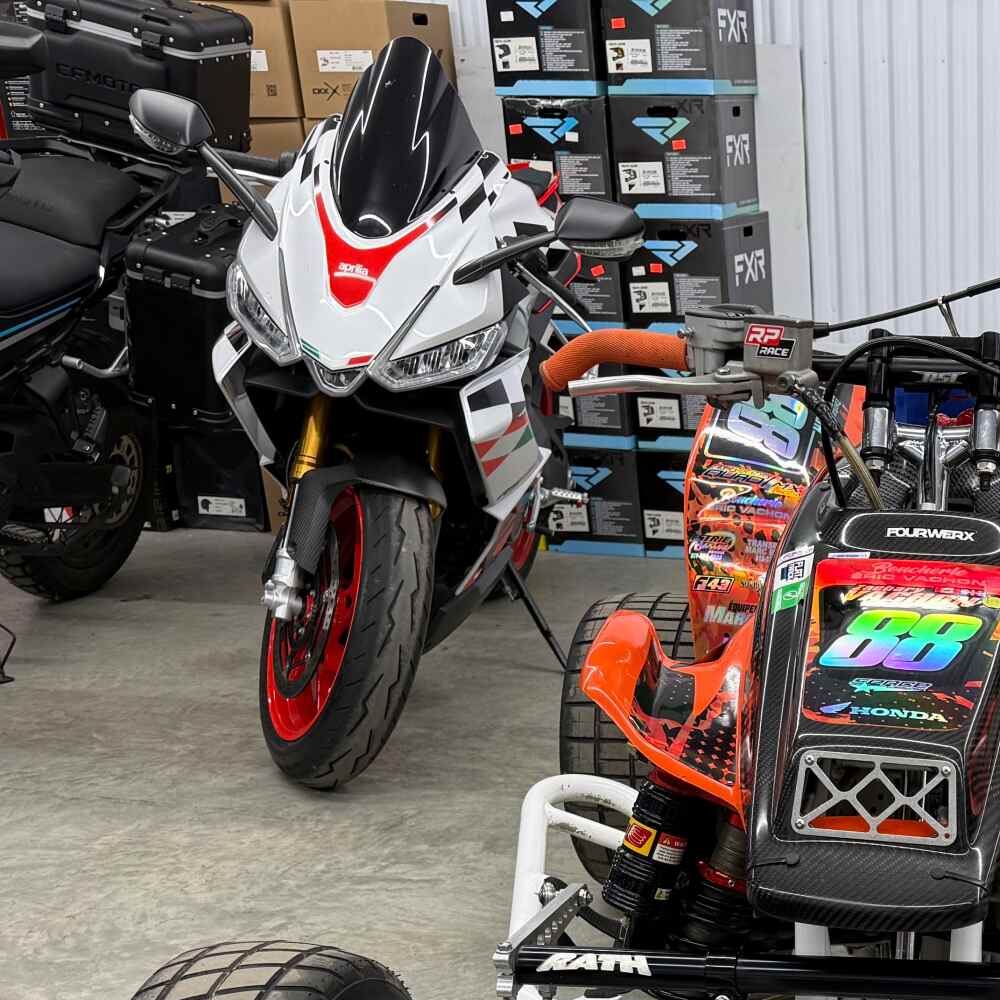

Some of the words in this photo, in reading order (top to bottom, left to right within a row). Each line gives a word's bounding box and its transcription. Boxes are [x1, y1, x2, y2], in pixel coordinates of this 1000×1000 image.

[717, 8, 748, 43] FXR
[726, 133, 750, 167] FXR
[338, 262, 369, 276] aprilia
[734, 248, 766, 287] FXR
[748, 326, 781, 344] RP
[759, 346, 789, 356] RACE
[886, 527, 976, 542] FOURWERX
[904, 574, 986, 587] VACHON
[819, 609, 983, 672] 88
[850, 706, 948, 723] HONDA
[536, 953, 652, 976] RATH
